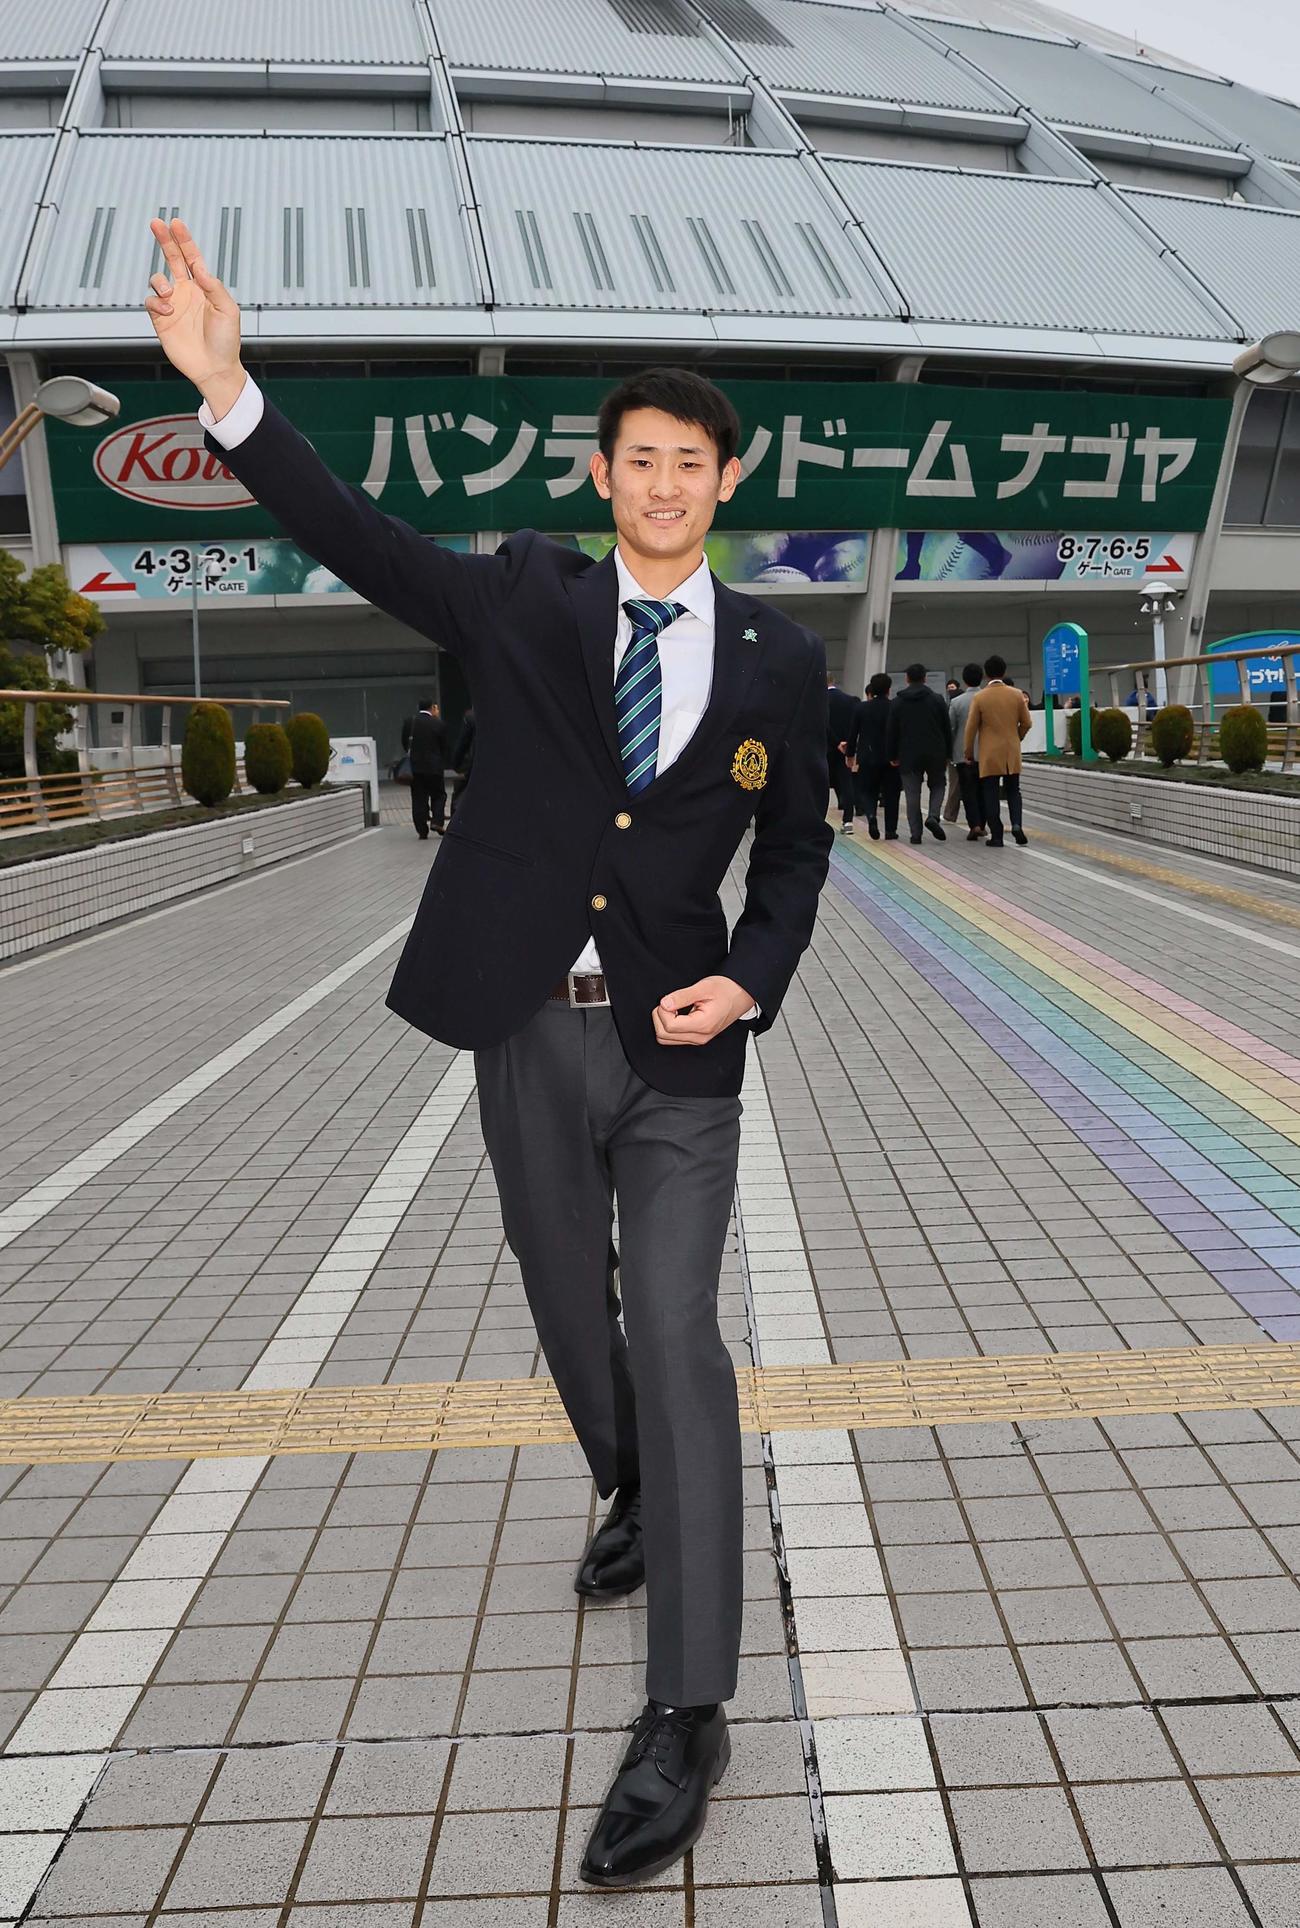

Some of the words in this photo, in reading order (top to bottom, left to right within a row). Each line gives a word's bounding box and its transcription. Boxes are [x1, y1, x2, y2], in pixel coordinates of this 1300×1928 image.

[996, 421, 1198, 502] ナゴヤ
[1077, 561, 1113, 576] ゲート
[1113, 568, 1132, 576] GATE
[219, 582, 245, 592] GATE
